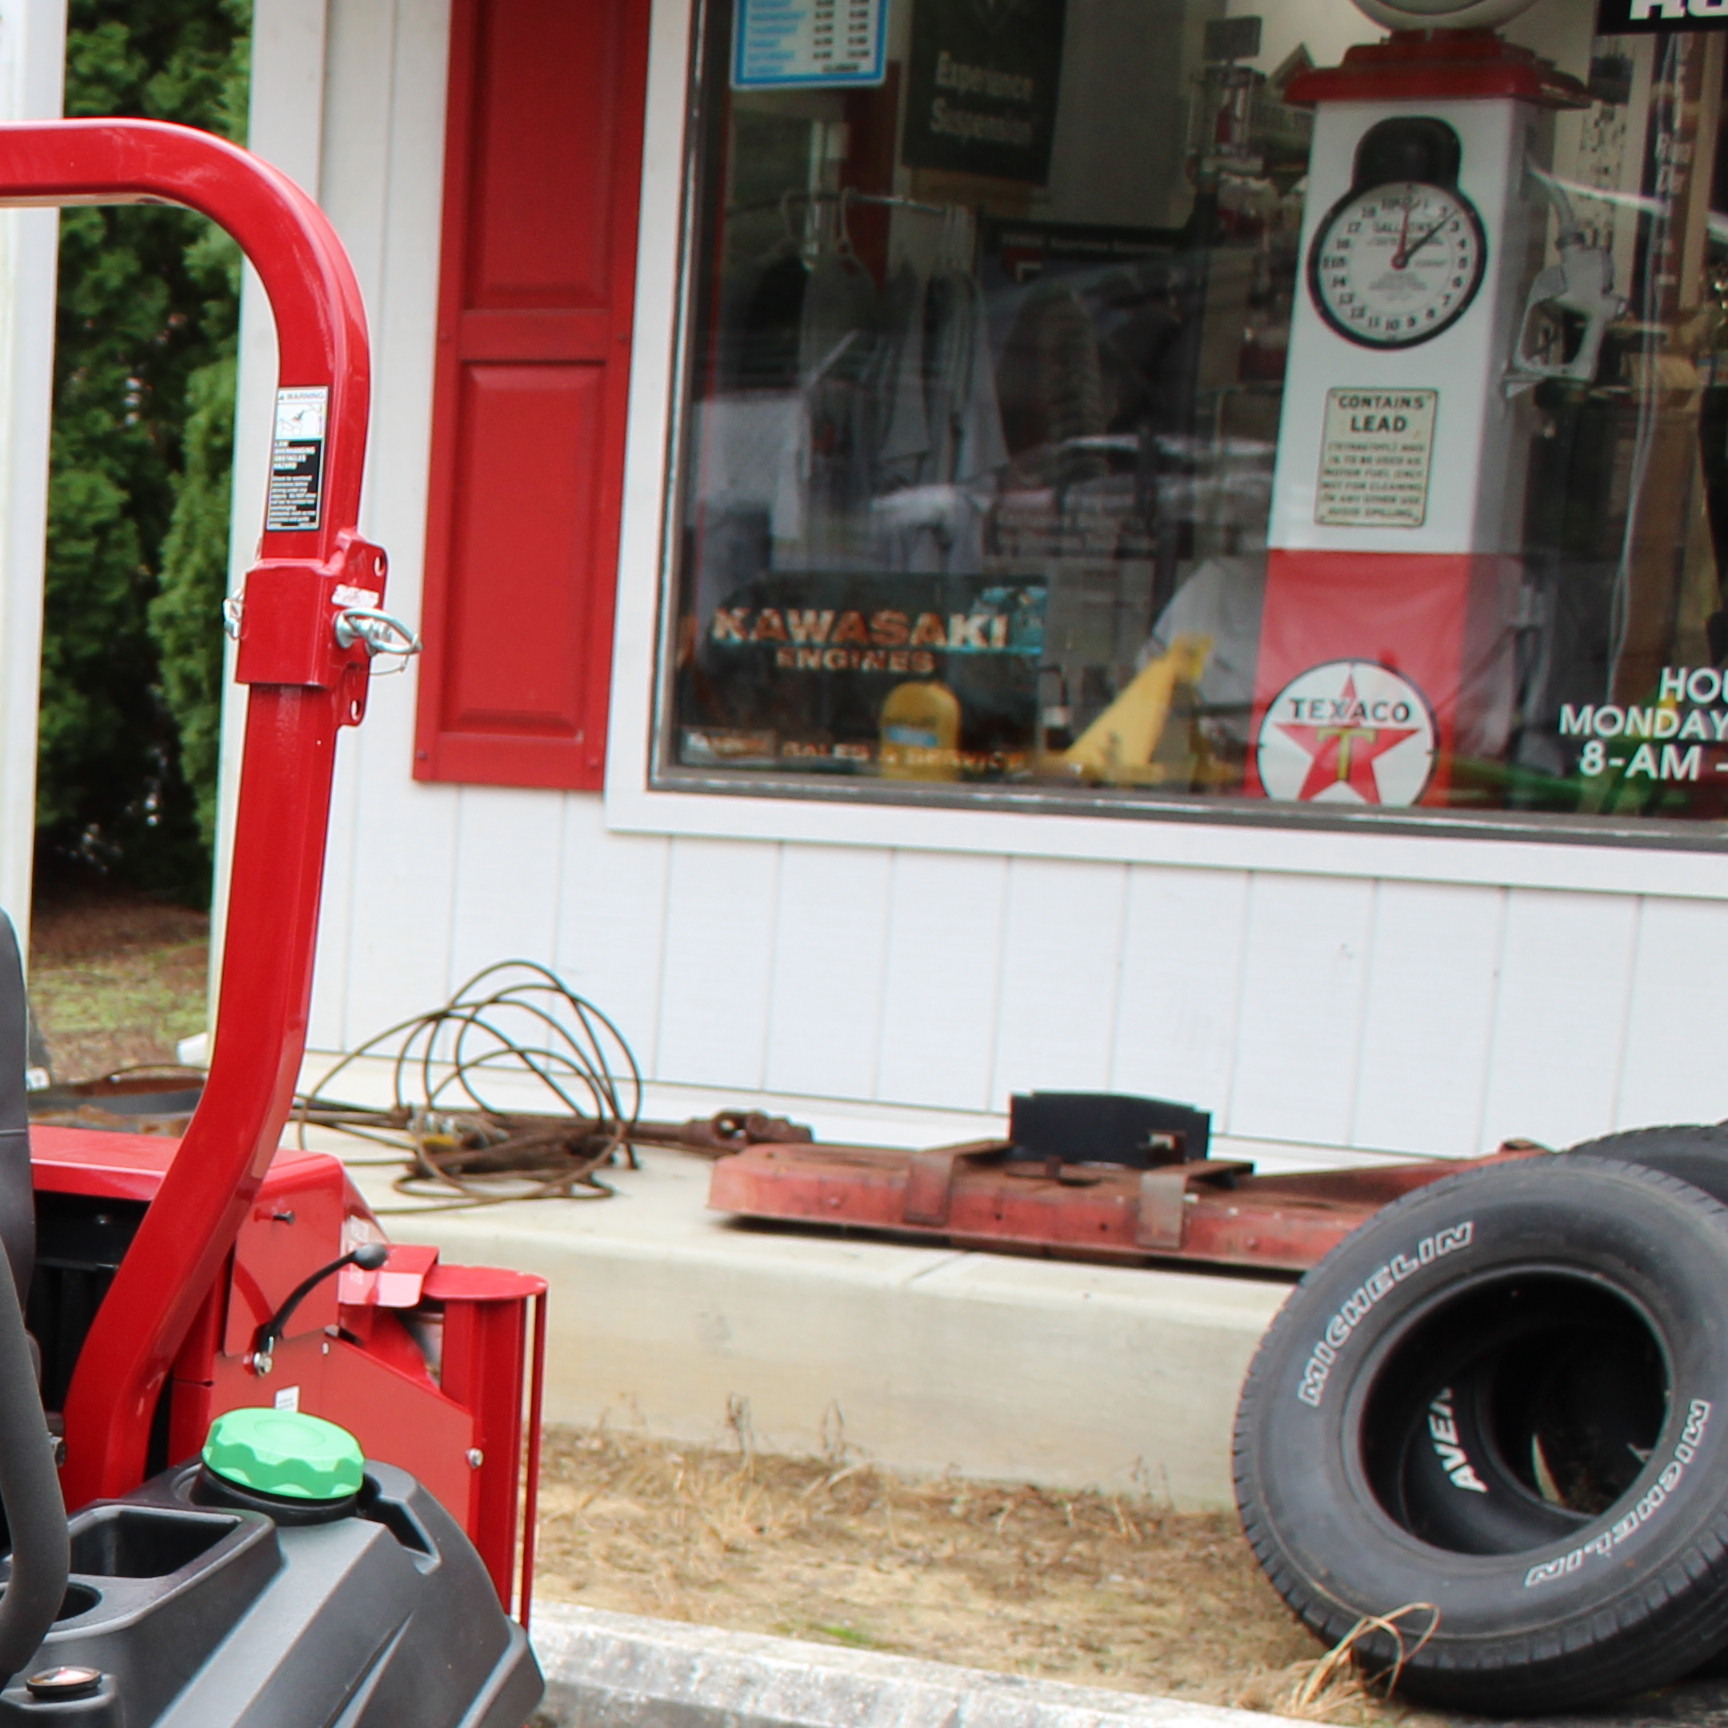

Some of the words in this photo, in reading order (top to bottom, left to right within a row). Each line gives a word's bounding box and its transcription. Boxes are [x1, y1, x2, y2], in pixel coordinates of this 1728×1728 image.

[1338, 395, 1424, 409] CONTAINS
[1350, 416, 1407, 432] LEAD
[712, 607, 1008, 649] KAWASAKI
[775, 647, 935, 673] ENGINES
[1661, 667, 1728, 704] HO
[1290, 698, 1411, 722] TEXACO
[1559, 704, 1728, 740] MONDAY
[1580, 741, 1701, 781] 8-AM
[1298, 1221, 1474, 1407] MICHELIN
[1525, 1399, 1711, 1587] MICHELIN
